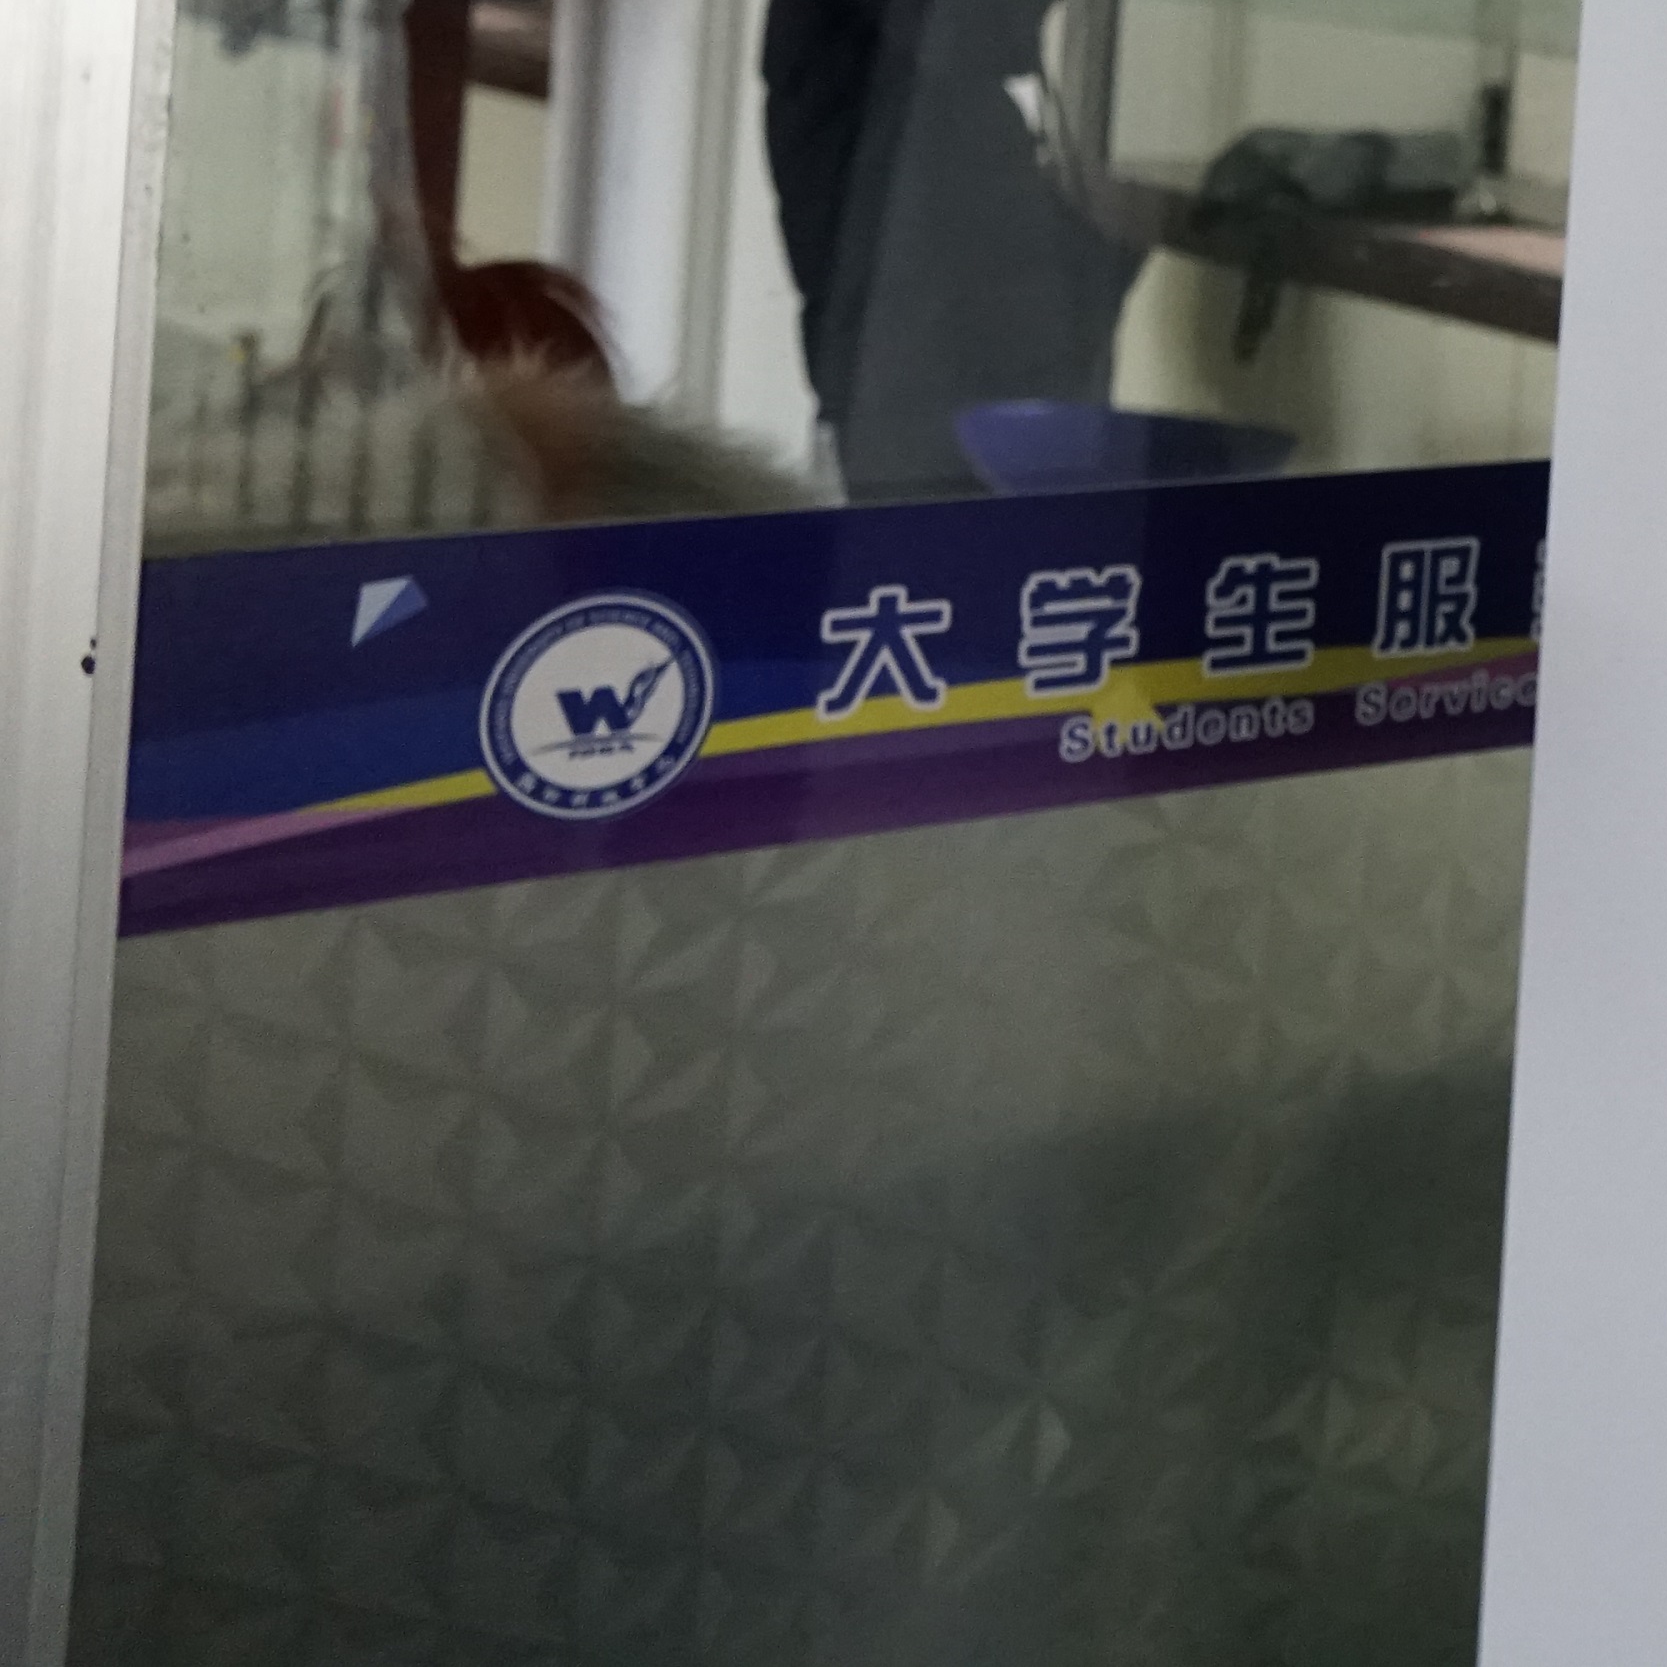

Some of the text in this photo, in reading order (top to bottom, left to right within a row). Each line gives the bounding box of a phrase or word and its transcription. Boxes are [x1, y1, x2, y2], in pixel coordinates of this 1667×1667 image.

[816, 537, 1547, 722] 大学生服
[1059, 696, 1315, 764] Students
